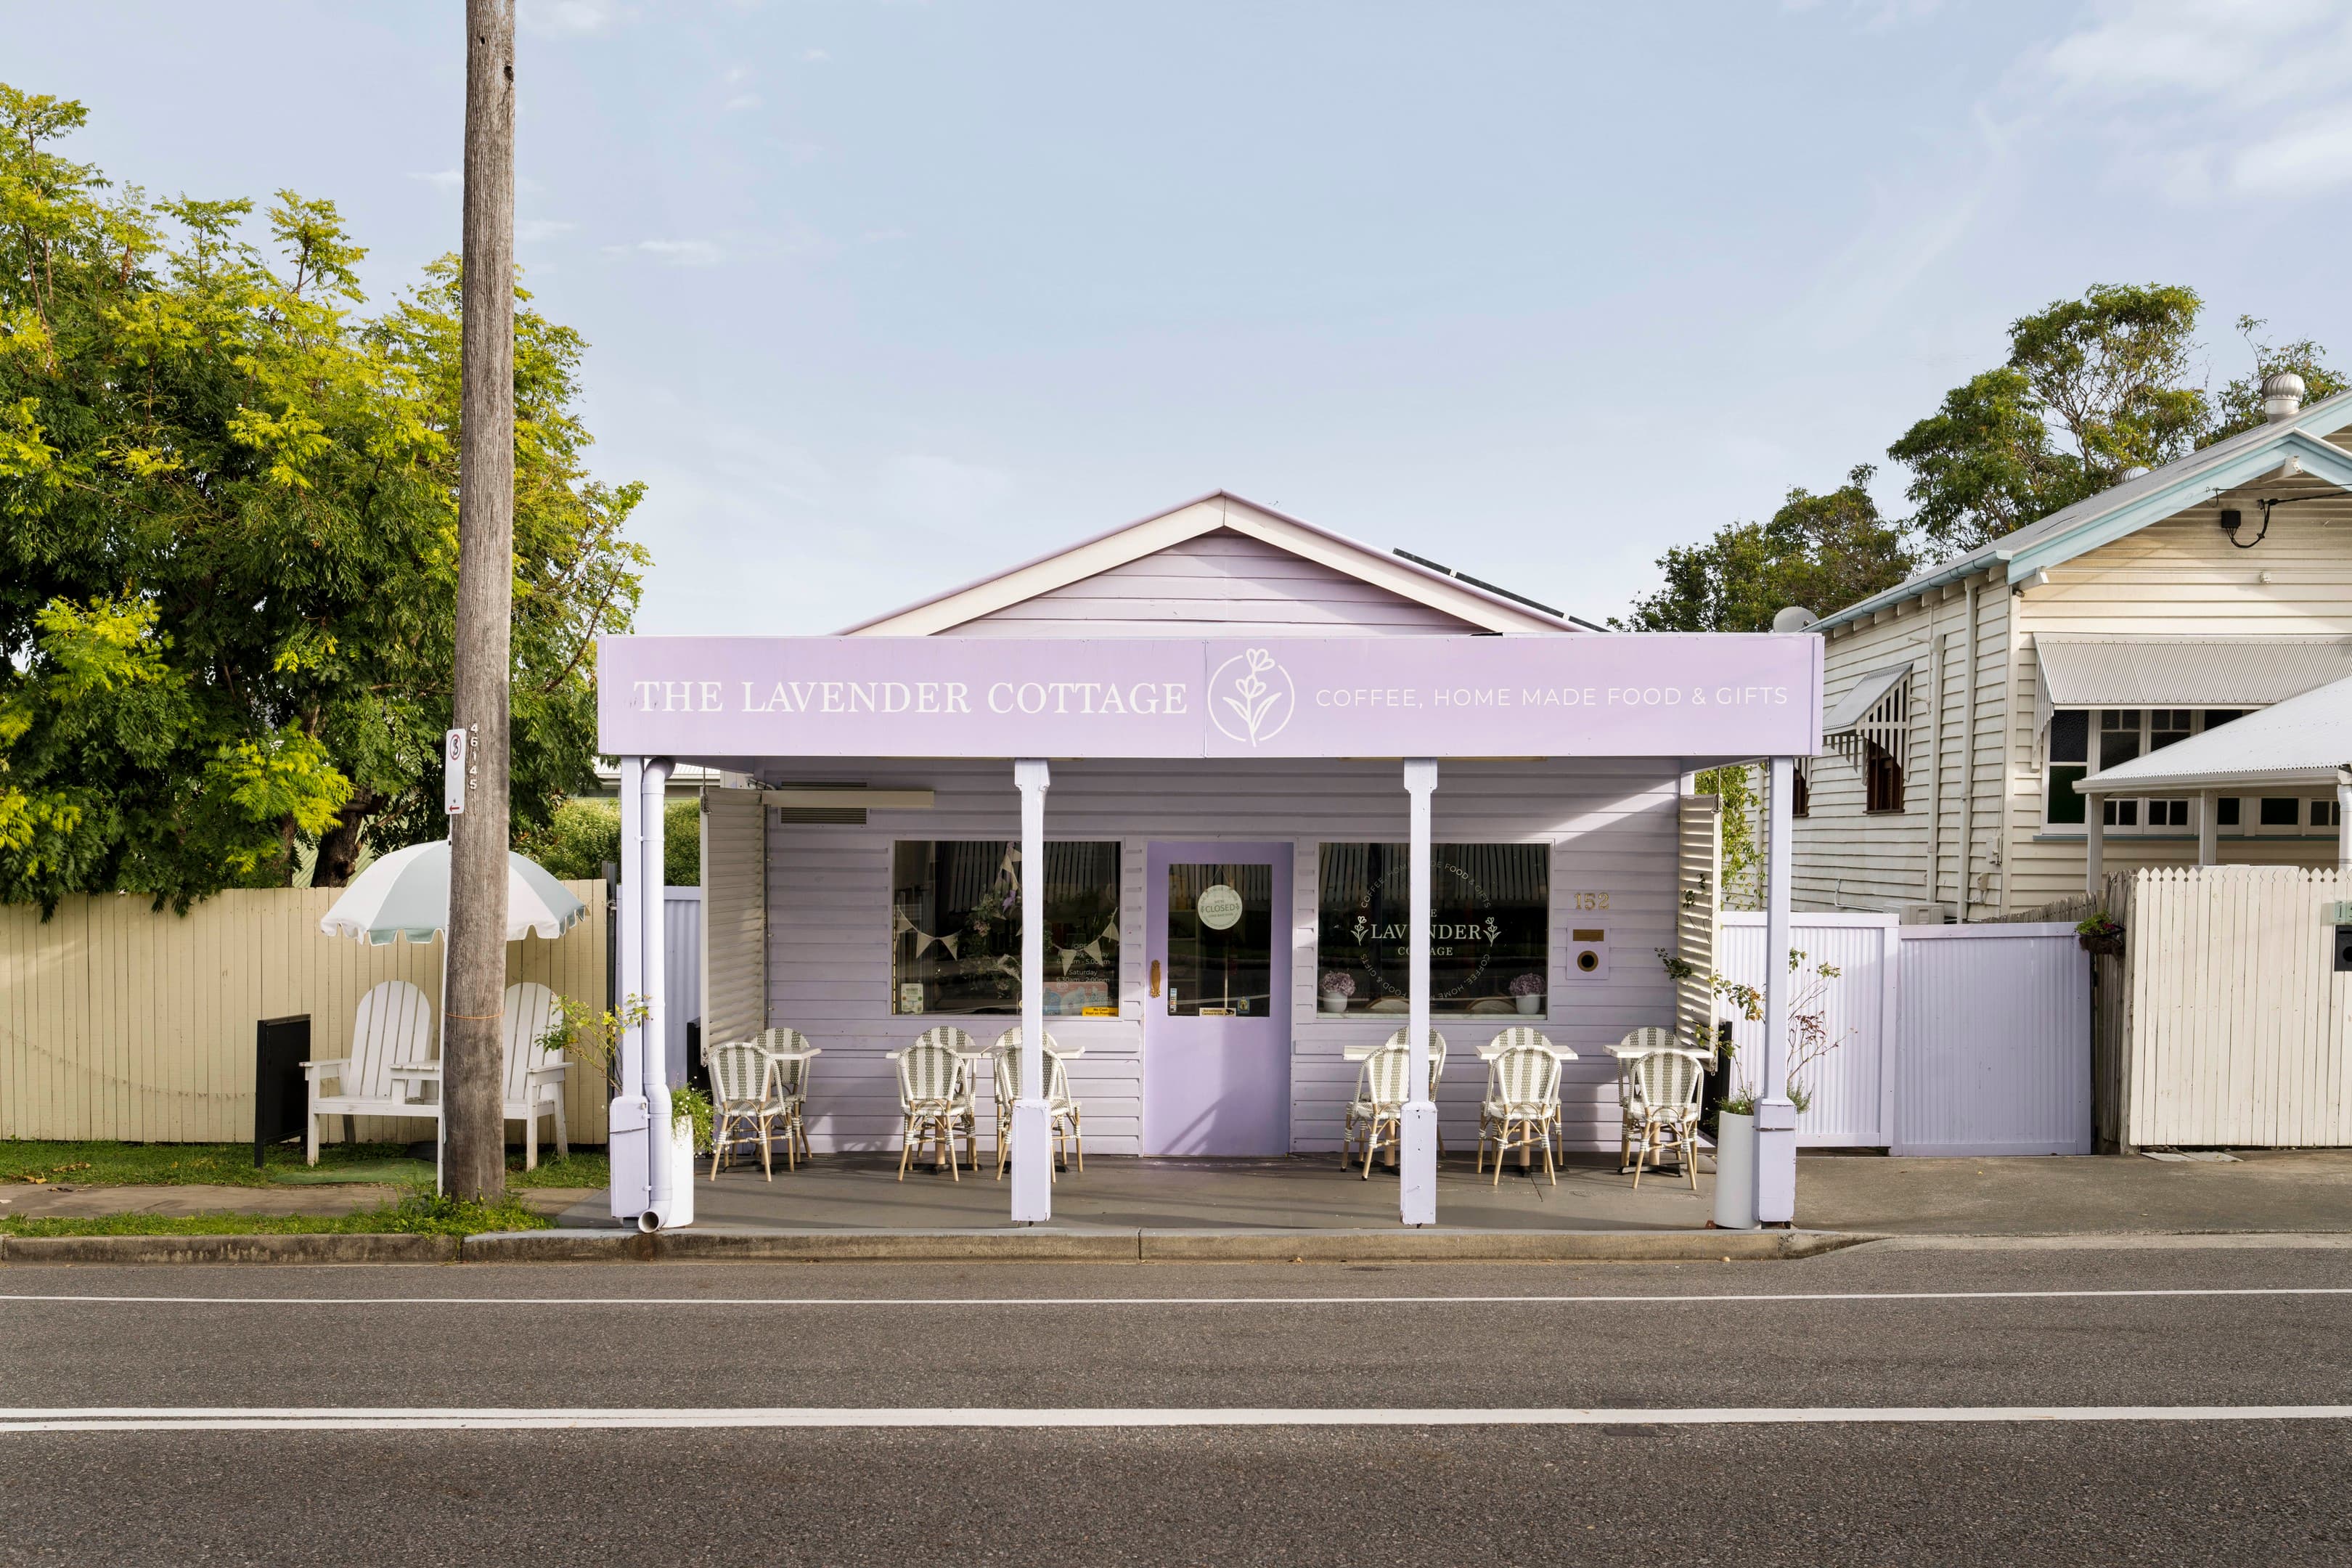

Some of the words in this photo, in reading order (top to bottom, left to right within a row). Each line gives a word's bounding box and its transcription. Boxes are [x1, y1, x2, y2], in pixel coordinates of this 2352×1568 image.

[633, 681, 724, 712] THE
[740, 681, 971, 714] LAVENDER
[987, 682, 1188, 714] COTTAGE
[1315, 689, 1423, 709] COFFEE,
[1434, 688, 1511, 706] HOME
[1522, 687, 1596, 706] MADE
[1608, 687, 1681, 706] FOOD
[1691, 687, 1707, 706] &
[1716, 687, 1788, 705] GIFTS
[1387, 864, 1407, 878] HOM
[1445, 863, 1469, 879] FOOD
[1475, 885, 1491, 908] GIFTS
[1205, 904, 1236, 912] CLOSED
[1574, 893, 1609, 910] 152
[1371, 923, 1482, 939] LAVNDER
[1397, 947, 1453, 956] CAGE
[1360, 953, 1377, 976] GIFTS
[1382, 982, 1407, 998] FOOD
[1438, 984, 1464, 999] HOME
